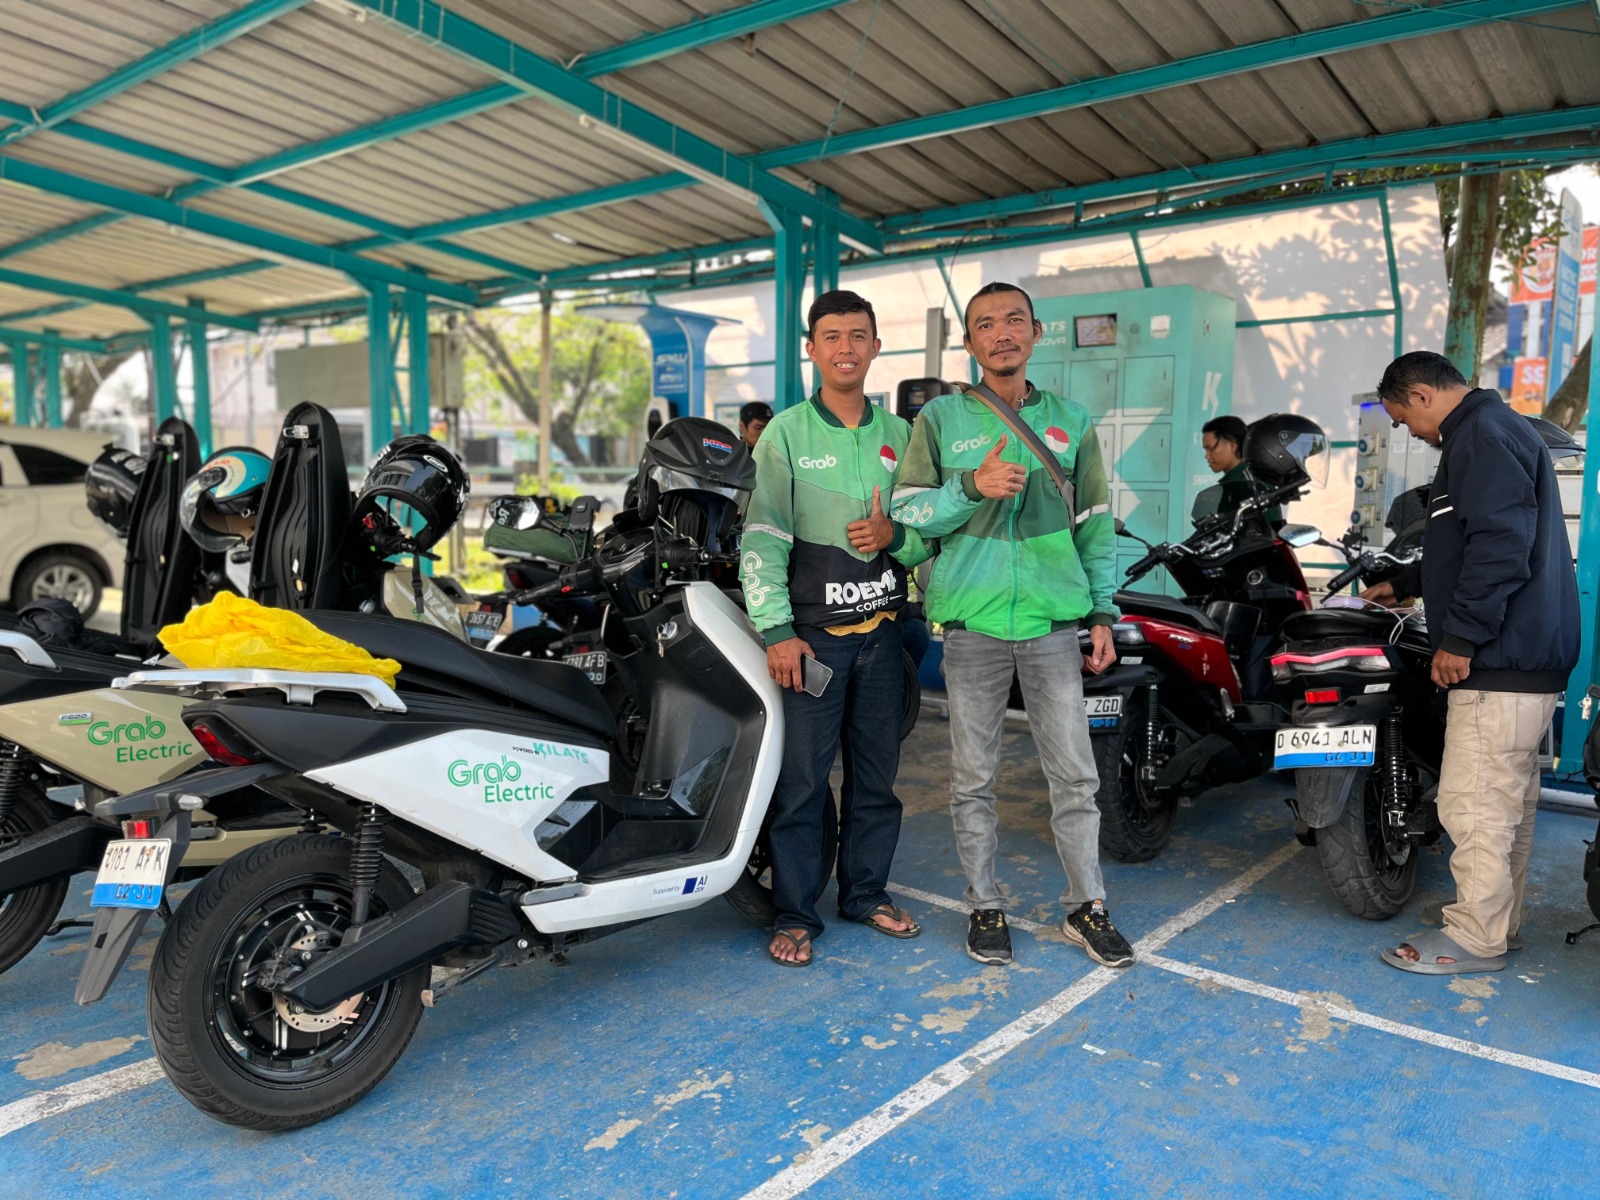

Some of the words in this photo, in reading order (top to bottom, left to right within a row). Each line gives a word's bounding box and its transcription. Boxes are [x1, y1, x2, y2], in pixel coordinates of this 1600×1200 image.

[951, 434, 992, 453] Grab
[798, 454, 837, 469] Grab
[856, 595, 889, 613] COFFEE
[584, 654, 605, 668] AFB
[1095, 699, 1119, 713] ZGD
[87, 716, 166, 746] Grab
[1277, 734, 1285, 749] D
[1291, 731, 1331, 747] 6941
[1341, 729, 1373, 745] ALN
[116, 741, 193, 763] Electric
[533, 742, 589, 765] KILATS
[447, 755, 522, 787] Grab
[484, 782, 555, 803] Electric
